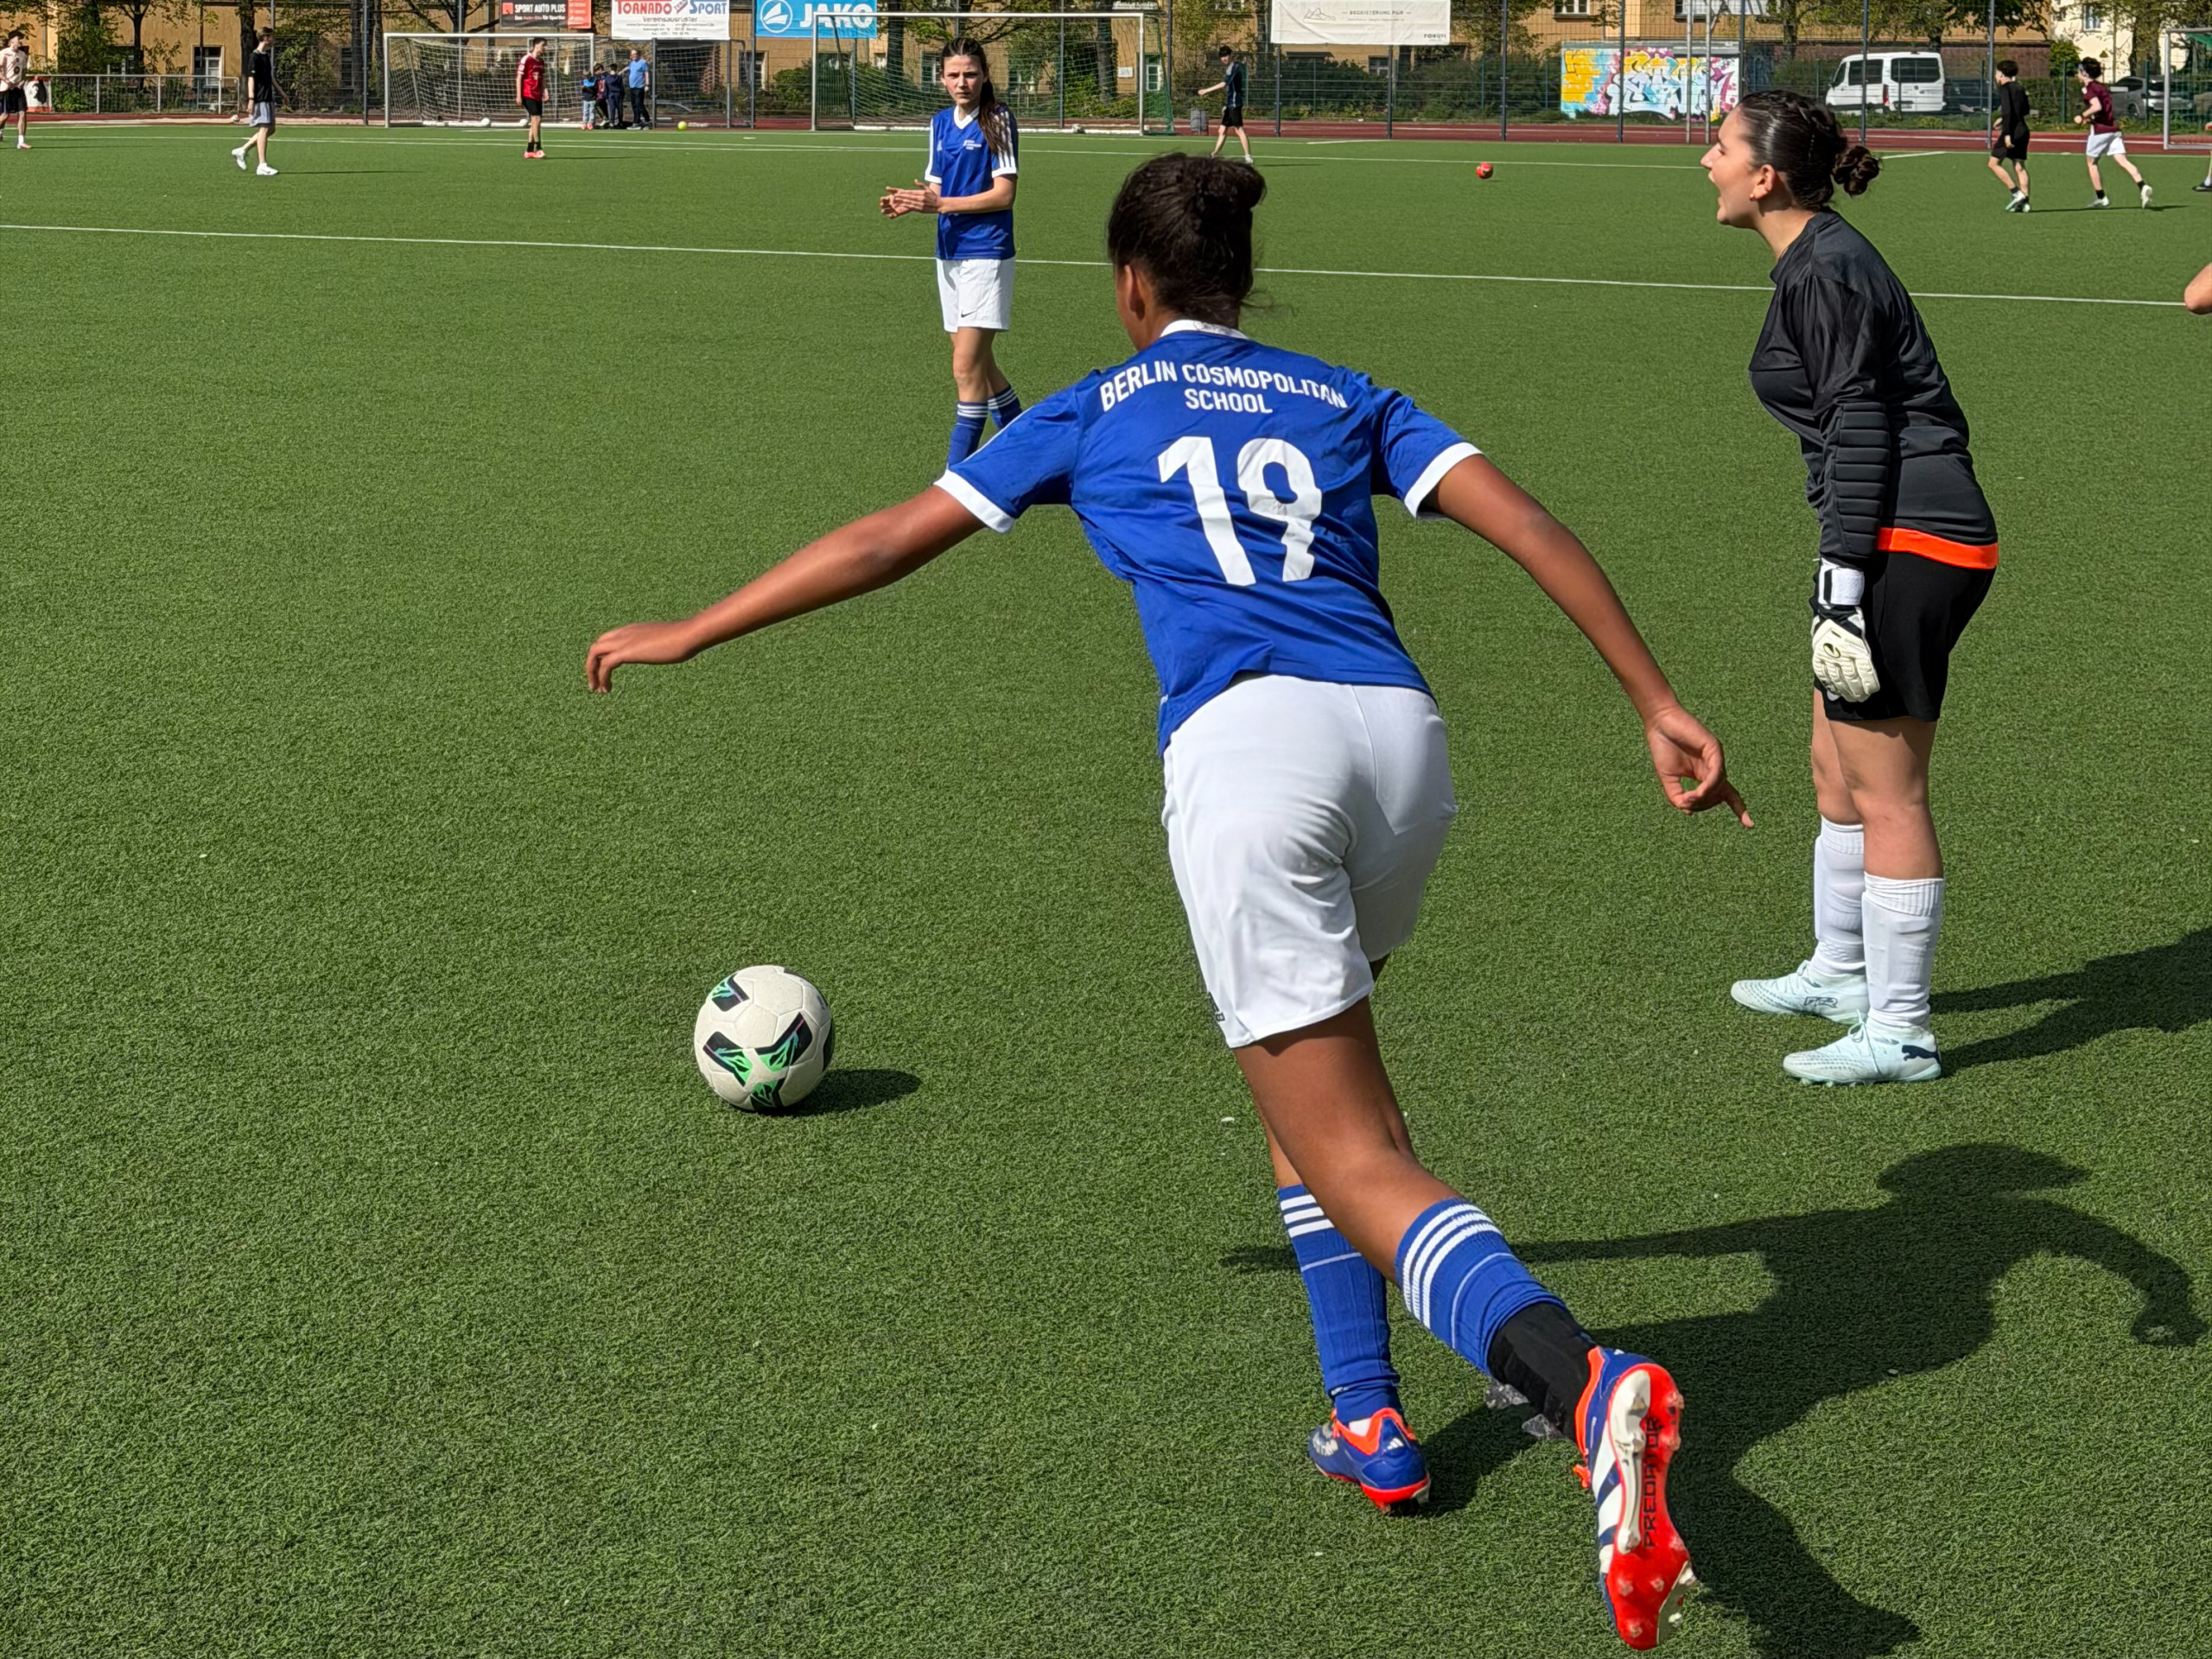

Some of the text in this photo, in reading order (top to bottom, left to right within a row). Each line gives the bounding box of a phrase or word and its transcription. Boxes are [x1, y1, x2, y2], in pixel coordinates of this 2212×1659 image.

[514, 3, 566, 13] SPORT AUTO PLUS
[615, 0, 672, 15] TORNADO
[690, 0, 727, 15] SPORT
[799, 3, 873, 28] JAKO
[1099, 360, 1349, 412] BERLIN COSMOPOLITAN
[1184, 388, 1273, 414] SCHOOL
[1157, 435, 1322, 587] 19
[1643, 1416, 1664, 1548] PREDATOR
